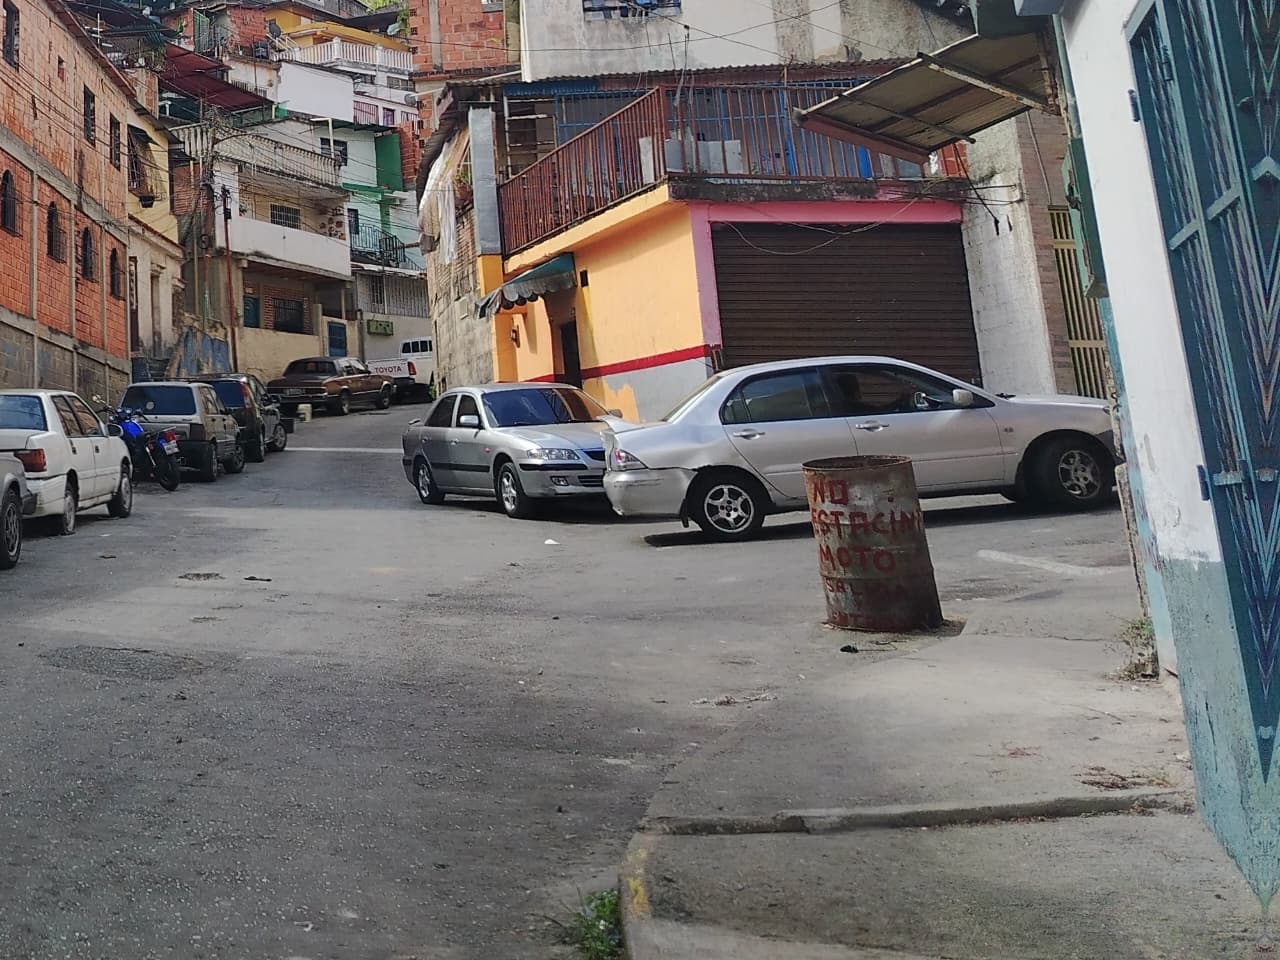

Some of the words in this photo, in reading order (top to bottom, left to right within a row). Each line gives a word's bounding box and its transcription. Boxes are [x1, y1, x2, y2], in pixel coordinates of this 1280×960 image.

[374, 365, 402, 374] TOYOTA
[813, 479, 849, 505] NO
[819, 544, 896, 573] MOTO
